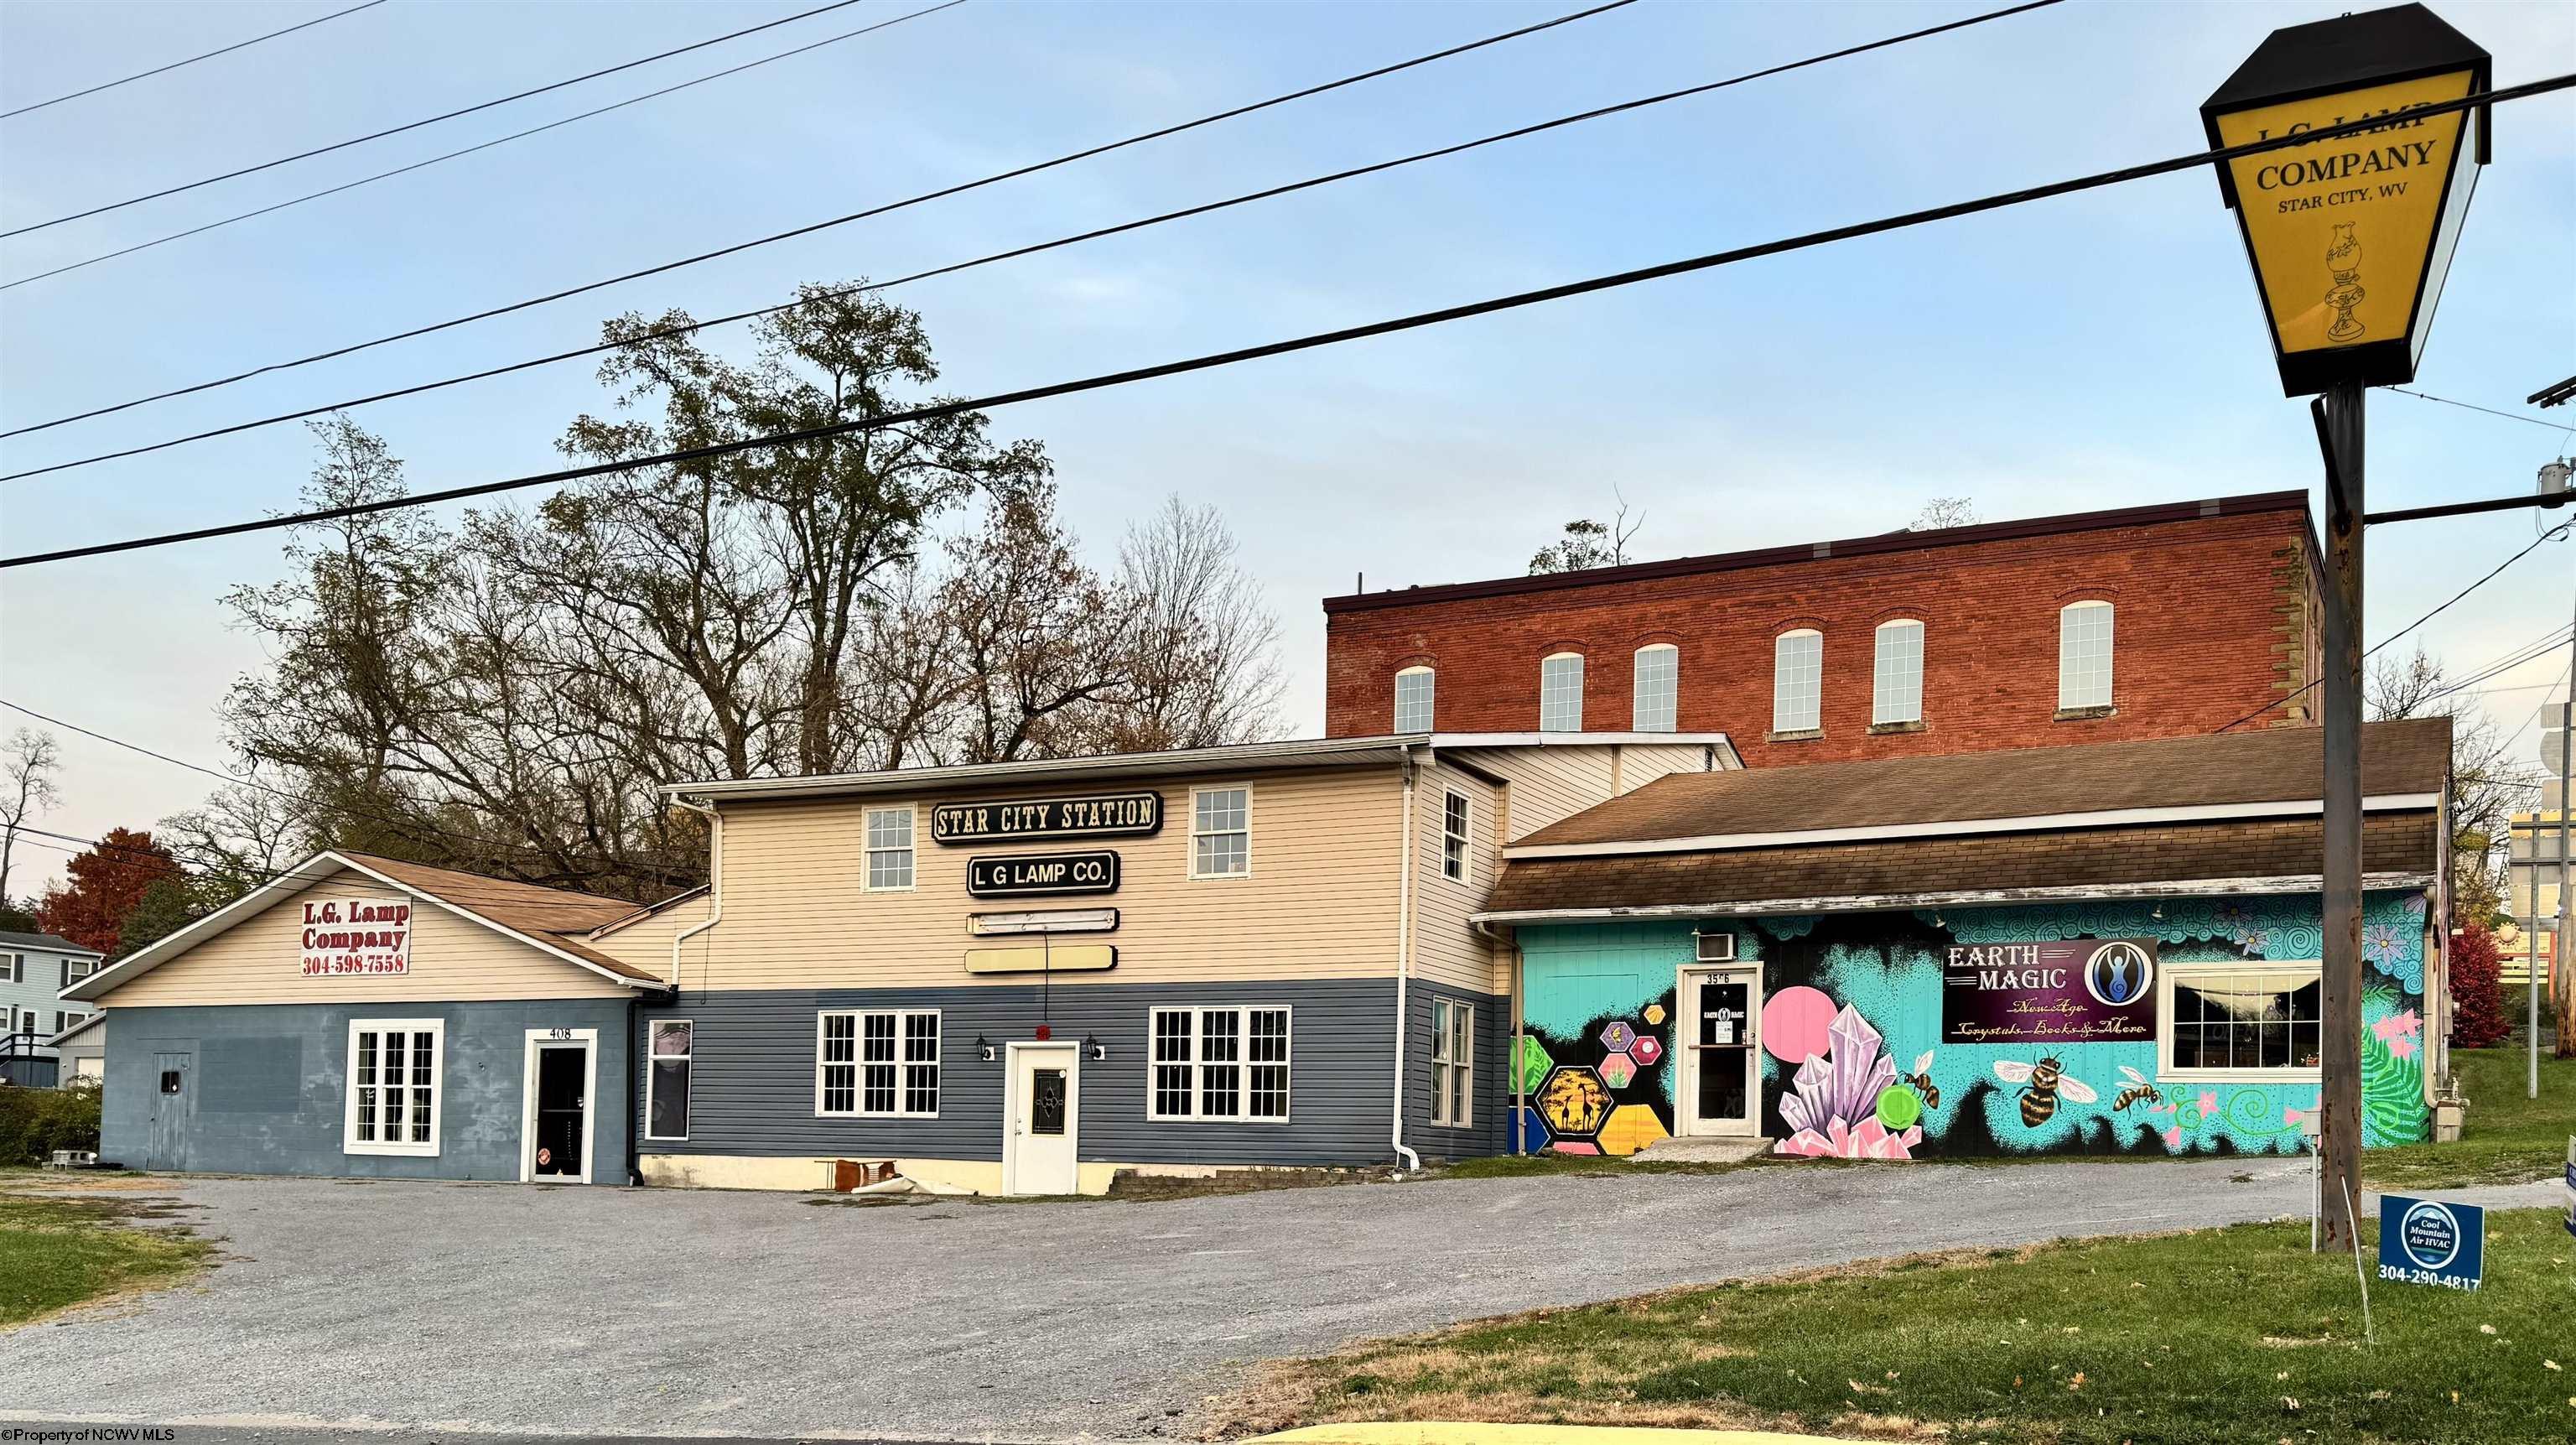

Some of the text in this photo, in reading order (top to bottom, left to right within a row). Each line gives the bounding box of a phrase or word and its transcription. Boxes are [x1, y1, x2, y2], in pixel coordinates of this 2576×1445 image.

[2257, 139, 2437, 190] COMPANY
[2278, 181, 2408, 214] STAR CITY, WV
[937, 798, 1153, 835] STAR CITY STATION
[975, 860, 1107, 886] L G LAMP CO.
[303, 902, 410, 927] L.G. Lamp
[302, 928, 407, 953] Company
[303, 954, 403, 975] 304-598-7558
[1949, 945, 2041, 968] EARTH
[1978, 968, 2067, 991] MAGIC
[2012, 997, 2089, 1018] New Age
[550, 1027, 571, 1040] 408
[2098, 1016, 2147, 1034] More
[2410, 1226, 2451, 1240] Mountain
[2421, 1219, 2441, 1229] Cool
[2410, 1235, 2452, 1249] Air HVAC
[2378, 1264, 2481, 1292] 304-290-4817
